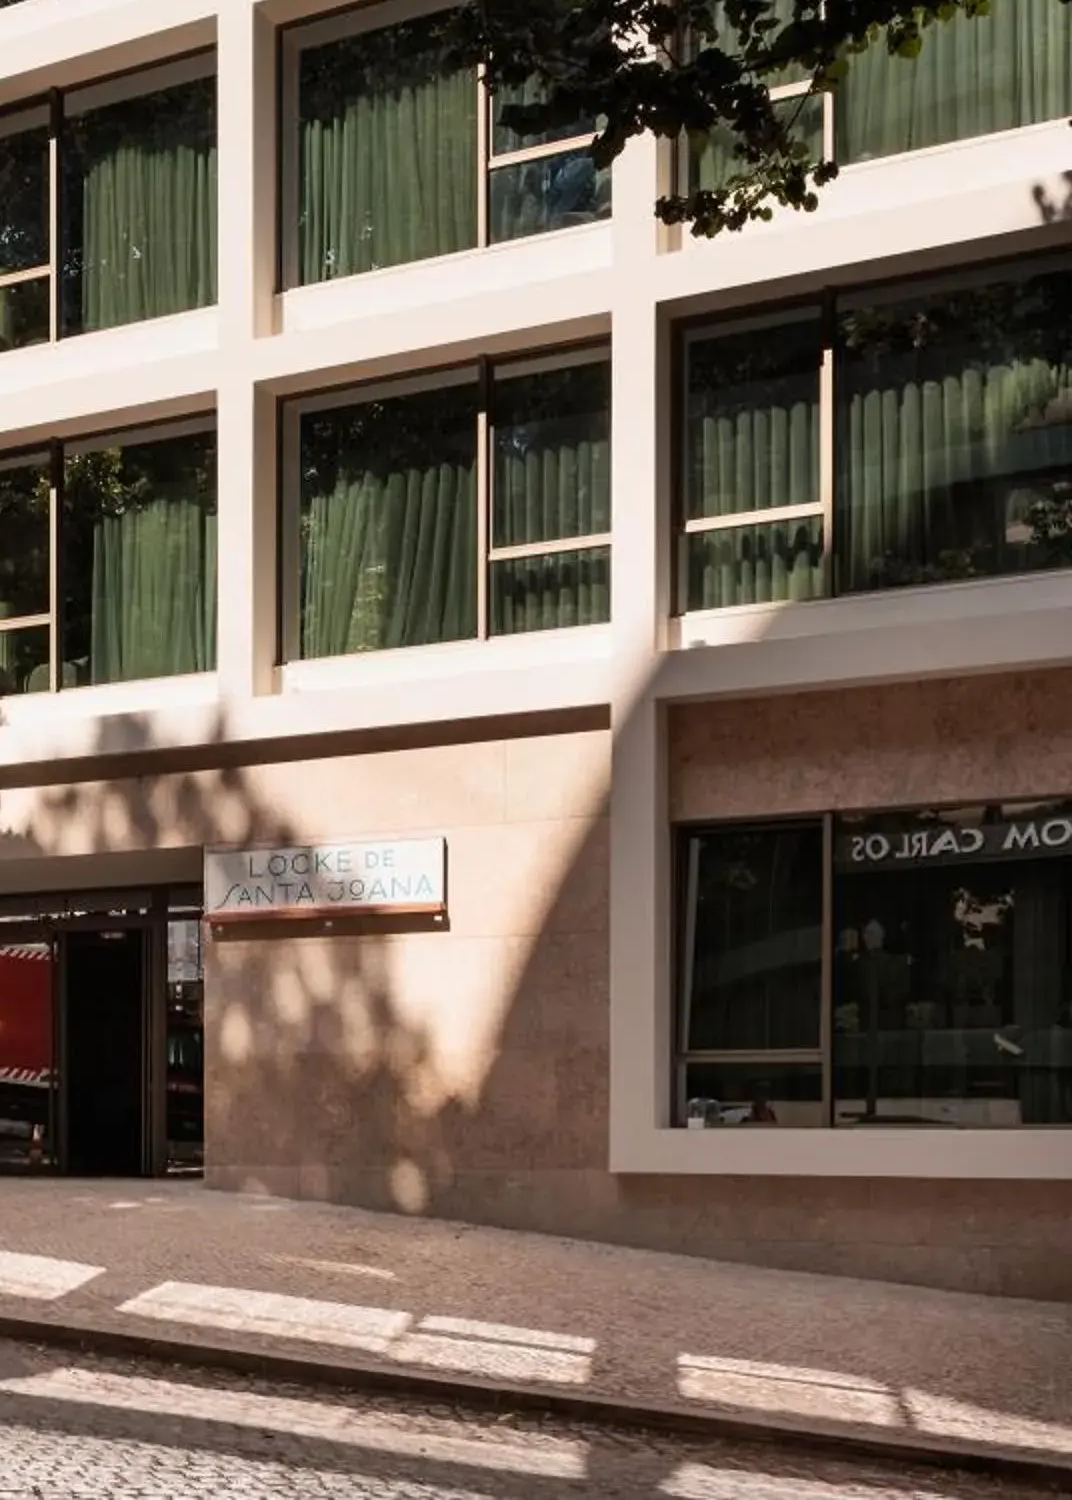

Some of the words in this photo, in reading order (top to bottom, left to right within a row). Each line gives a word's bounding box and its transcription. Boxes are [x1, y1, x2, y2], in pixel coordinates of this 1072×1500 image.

[249, 851, 352, 878] LOCKE
[364, 849, 395, 869] DE
[216, 881, 315, 909] SANTA
[327, 874, 434, 901] JOANA
